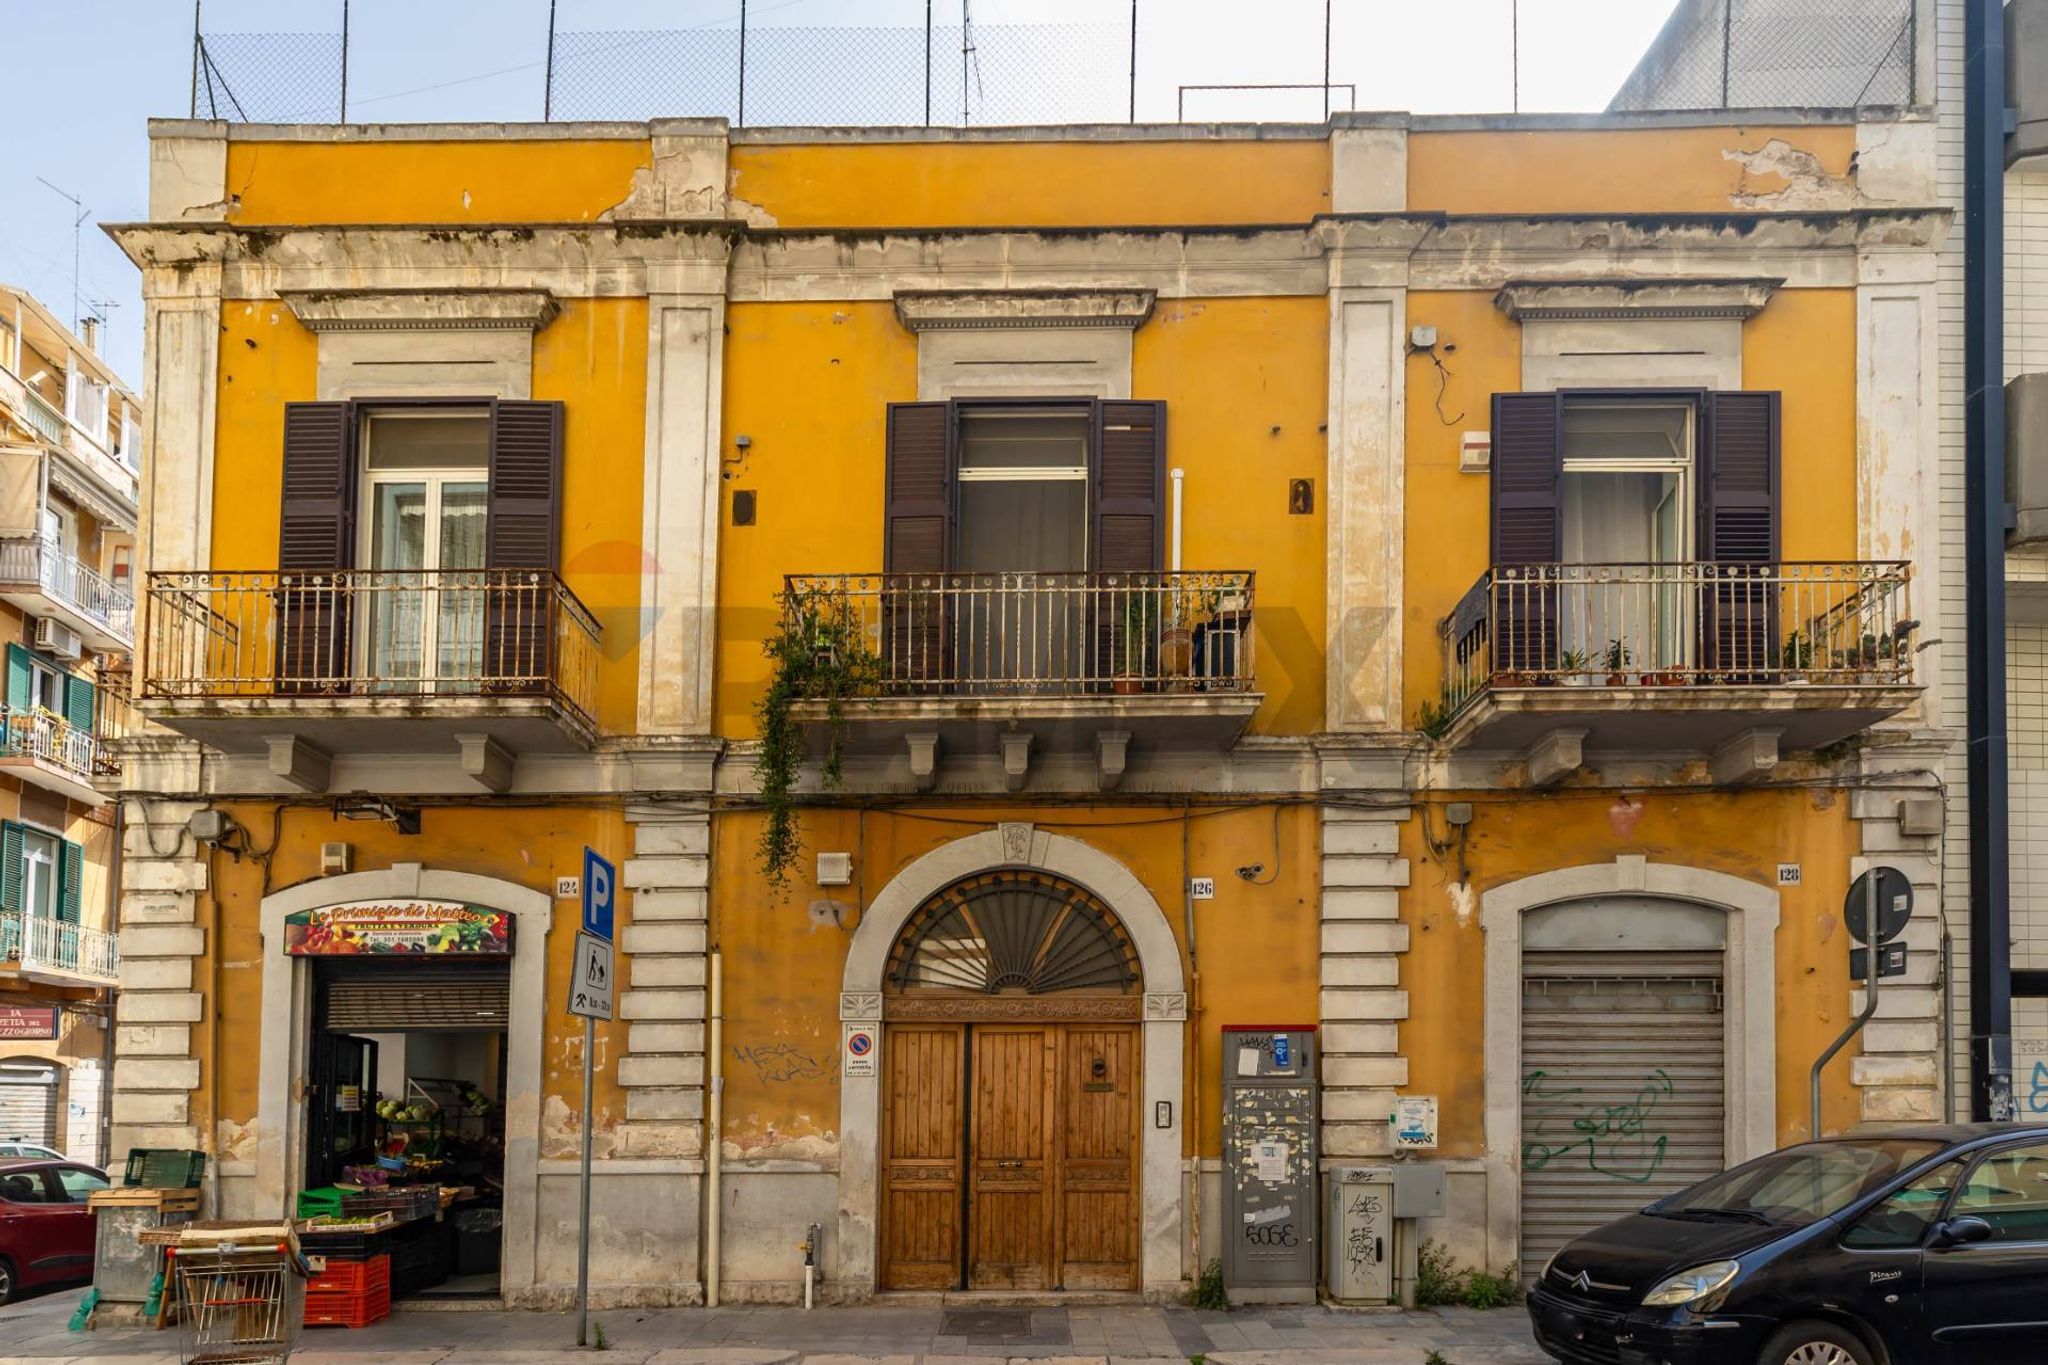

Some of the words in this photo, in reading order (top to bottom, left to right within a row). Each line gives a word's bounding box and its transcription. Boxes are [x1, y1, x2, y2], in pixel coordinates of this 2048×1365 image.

[1780, 868, 1799, 881] 128
[559, 880, 578, 894] 124
[590, 860, 610, 925] P
[1194, 882, 1212, 895] 126
[310, 910, 330, 926] Le
[403, 903, 425, 917] di
[425, 903, 482, 921] Matteo
